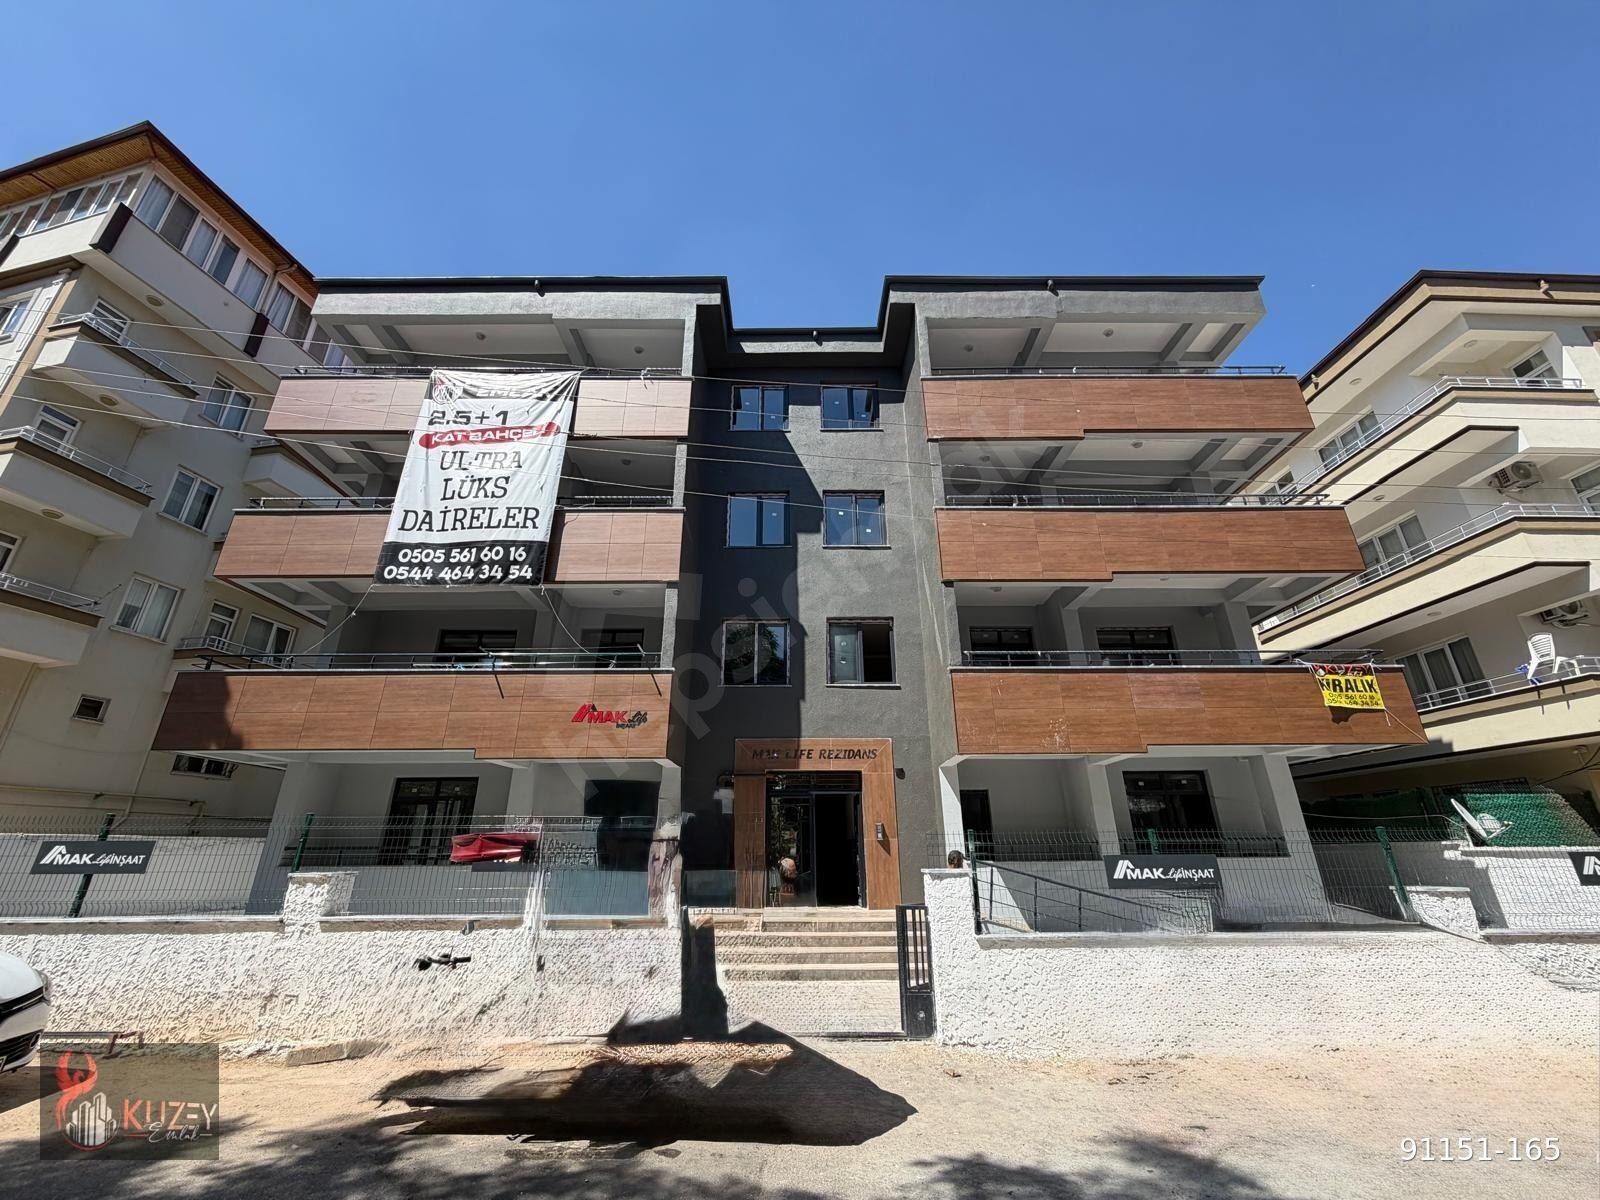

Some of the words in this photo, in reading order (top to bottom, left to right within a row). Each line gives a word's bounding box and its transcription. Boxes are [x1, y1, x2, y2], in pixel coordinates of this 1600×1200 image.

[427, 410, 509, 426] 2.5+1
[432, 433, 466, 445] KAT
[440, 450, 523, 471] ULTRA
[440, 475, 511, 501] LÜKS
[398, 506, 540, 532] DAİRELER
[398, 549, 445, 563] 0505
[449, 548, 477, 563] 561
[480, 546, 504, 560] 60
[509, 547, 527, 561] 16
[383, 565, 433, 580] 0544
[438, 565, 474, 580] 464
[479, 564, 503, 579] 34
[508, 565, 533, 579] 54
[588, 711, 628, 723] MAK
[785, 749, 814, 760] LIFE
[818, 749, 878, 760] REZIDANS
[53, 853, 95, 865] MAK
[110, 853, 146, 867] İNŞAAT
[1127, 868, 1165, 879] MAK
[1180, 868, 1214, 881] İNŞAAT
